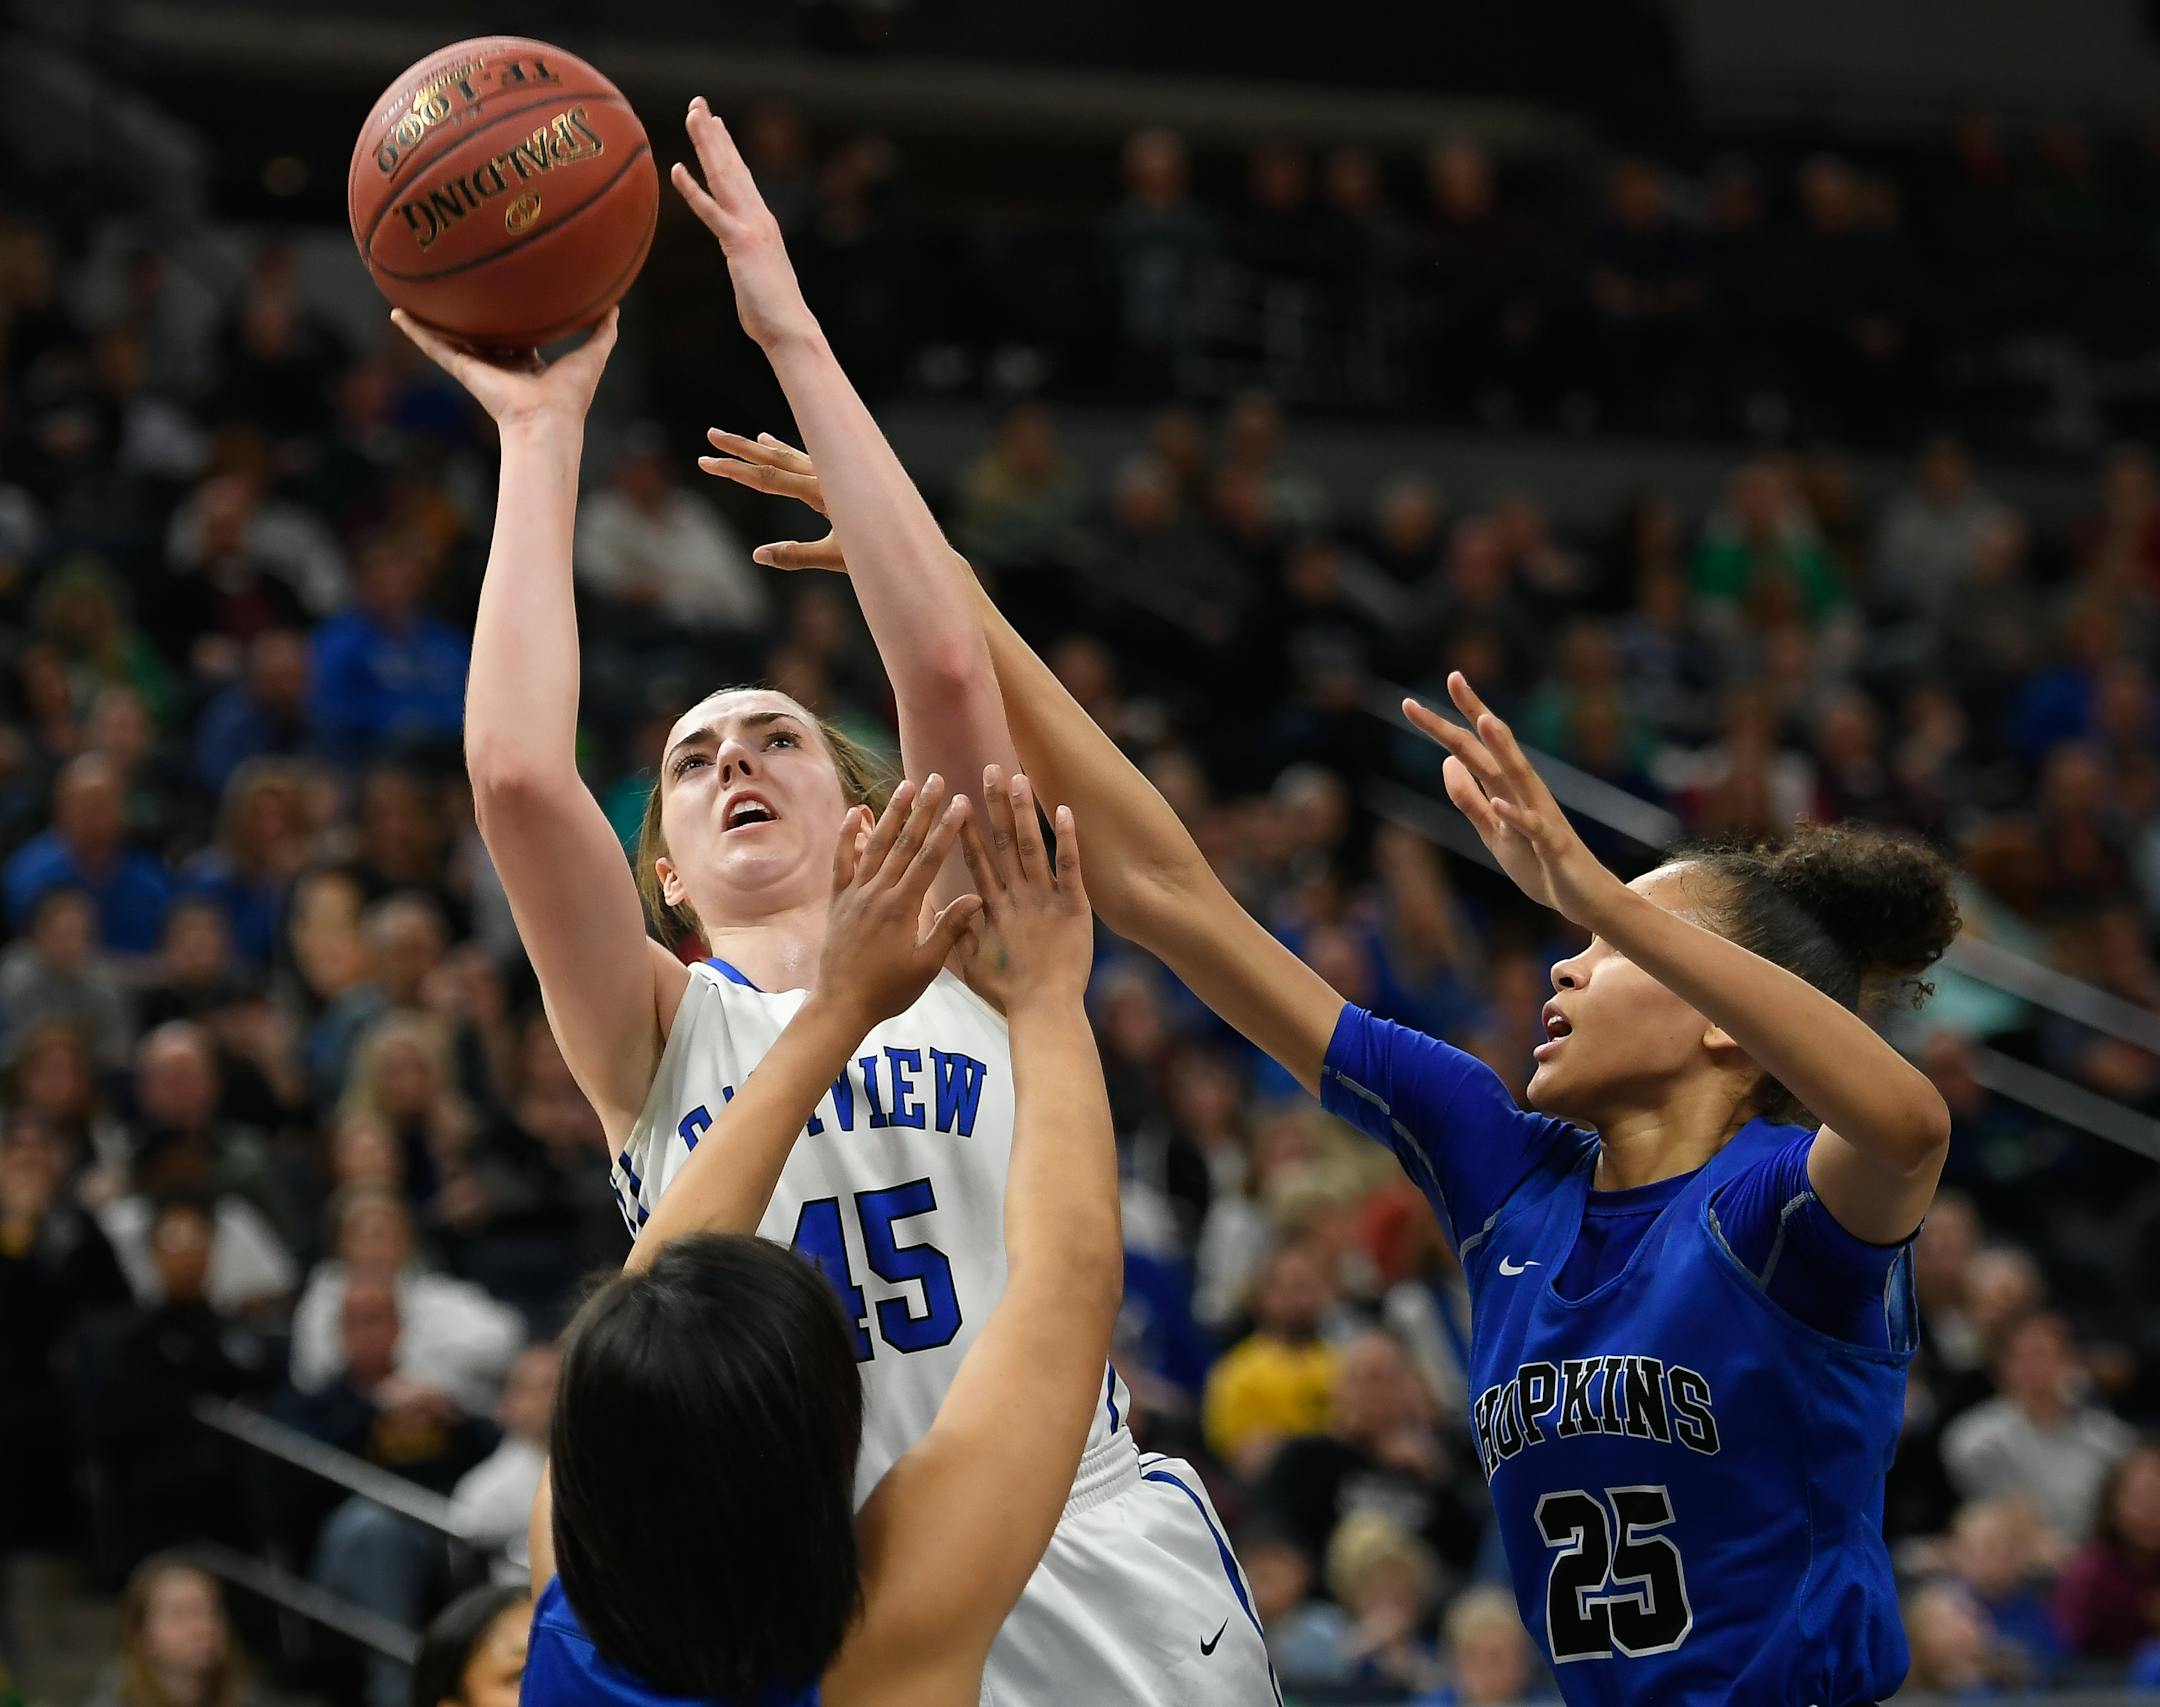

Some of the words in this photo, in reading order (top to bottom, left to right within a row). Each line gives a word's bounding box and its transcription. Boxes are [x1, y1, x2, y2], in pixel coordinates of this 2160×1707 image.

[400, 104, 604, 253] SPALDING
[678, 1046, 987, 1153] VIEW
[789, 1177, 963, 1364] 45
[1473, 1354, 1721, 1488] HOPKINS
[1533, 1484, 1694, 1665] 25
